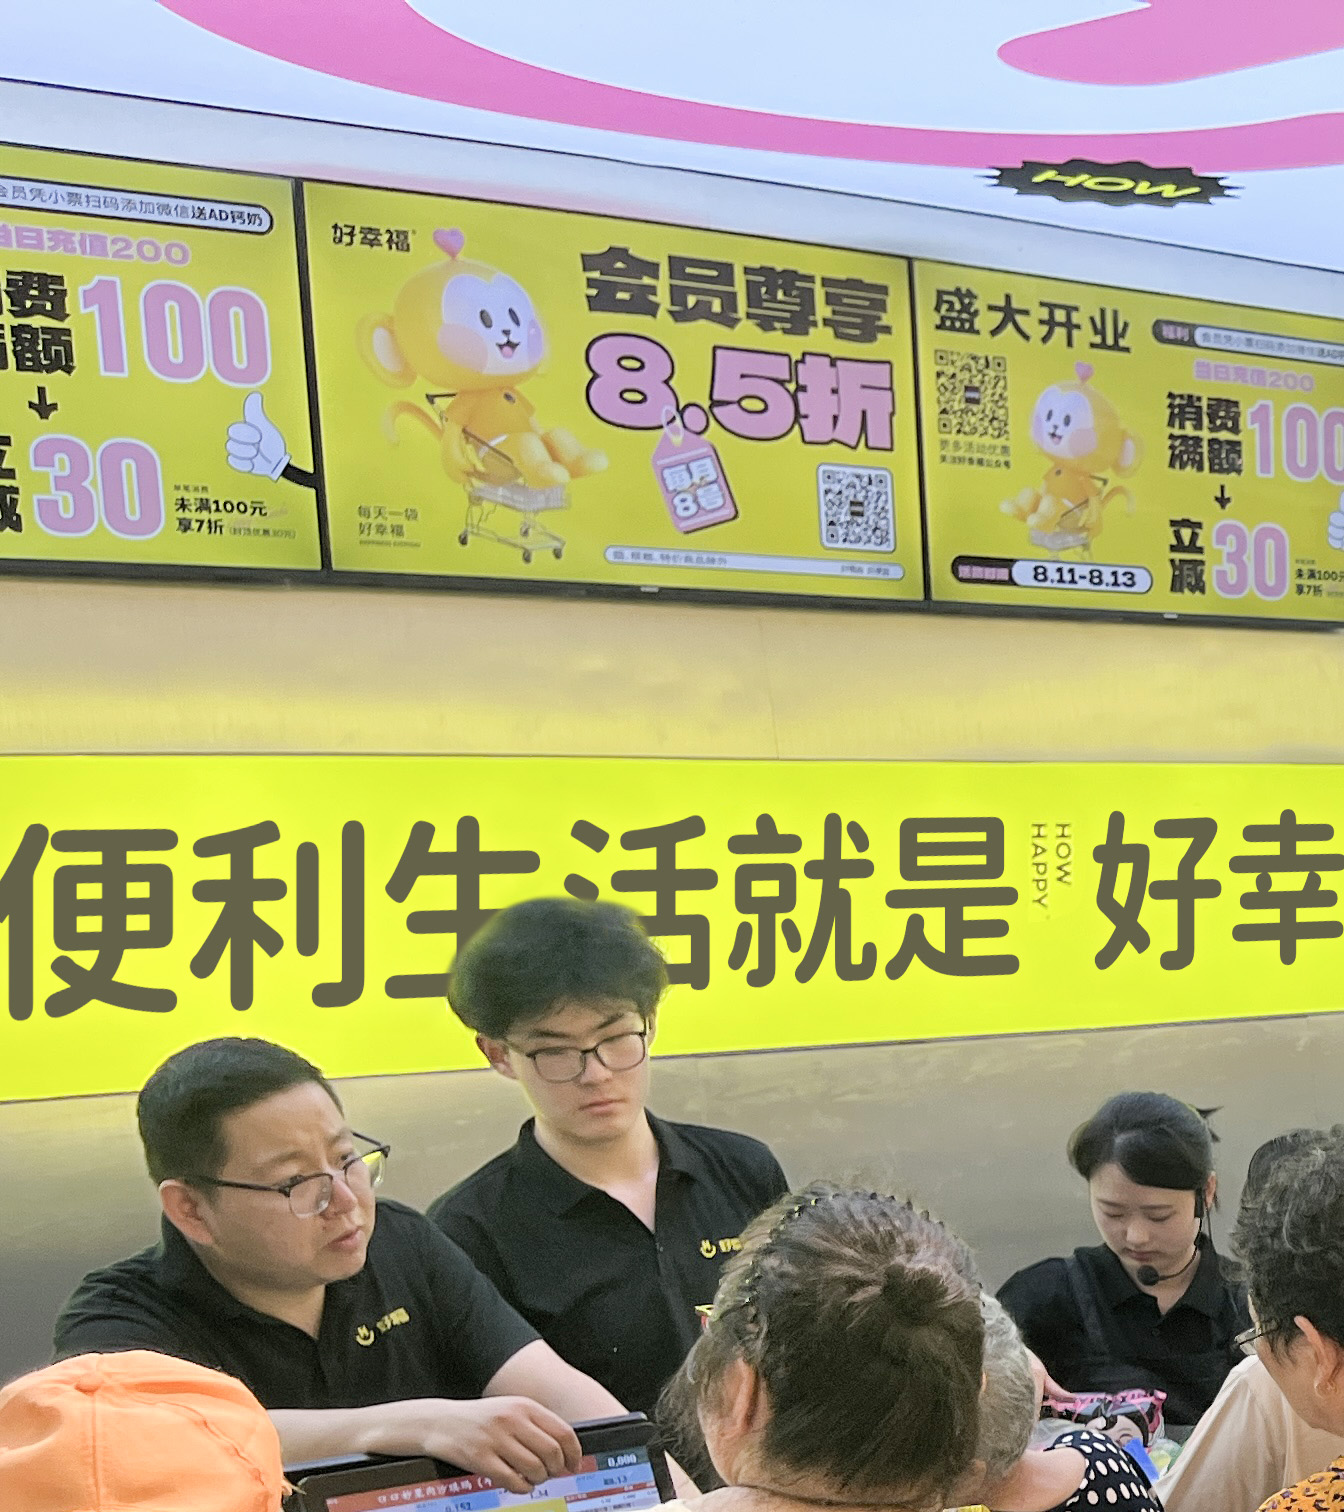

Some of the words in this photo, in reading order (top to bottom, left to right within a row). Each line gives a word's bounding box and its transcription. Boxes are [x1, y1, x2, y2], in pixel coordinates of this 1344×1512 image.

[1031, 169, 1201, 198] HOW
[331, 222, 411, 252] 好幸福
[0, 269, 71, 322] 费
[581, 246, 893, 343] 会员尊享
[934, 287, 1132, 355] 盛大开业
[0, 323, 76, 376] 额
[79, 275, 271, 387] 100
[585, 332, 895, 452] 8.5折
[1167, 391, 1242, 435] 消费
[1168, 433, 1243, 476] 满额
[30, 433, 165, 540] 30
[175, 496, 268, 518] 未满100元
[175, 516, 224, 536] 享7折
[1033, 563, 1138, 589] 8.11-8.13
[1212, 519, 1290, 601] 30
[1031, 822, 1049, 912] HAPPY
[1055, 822, 1072, 887] HOW
